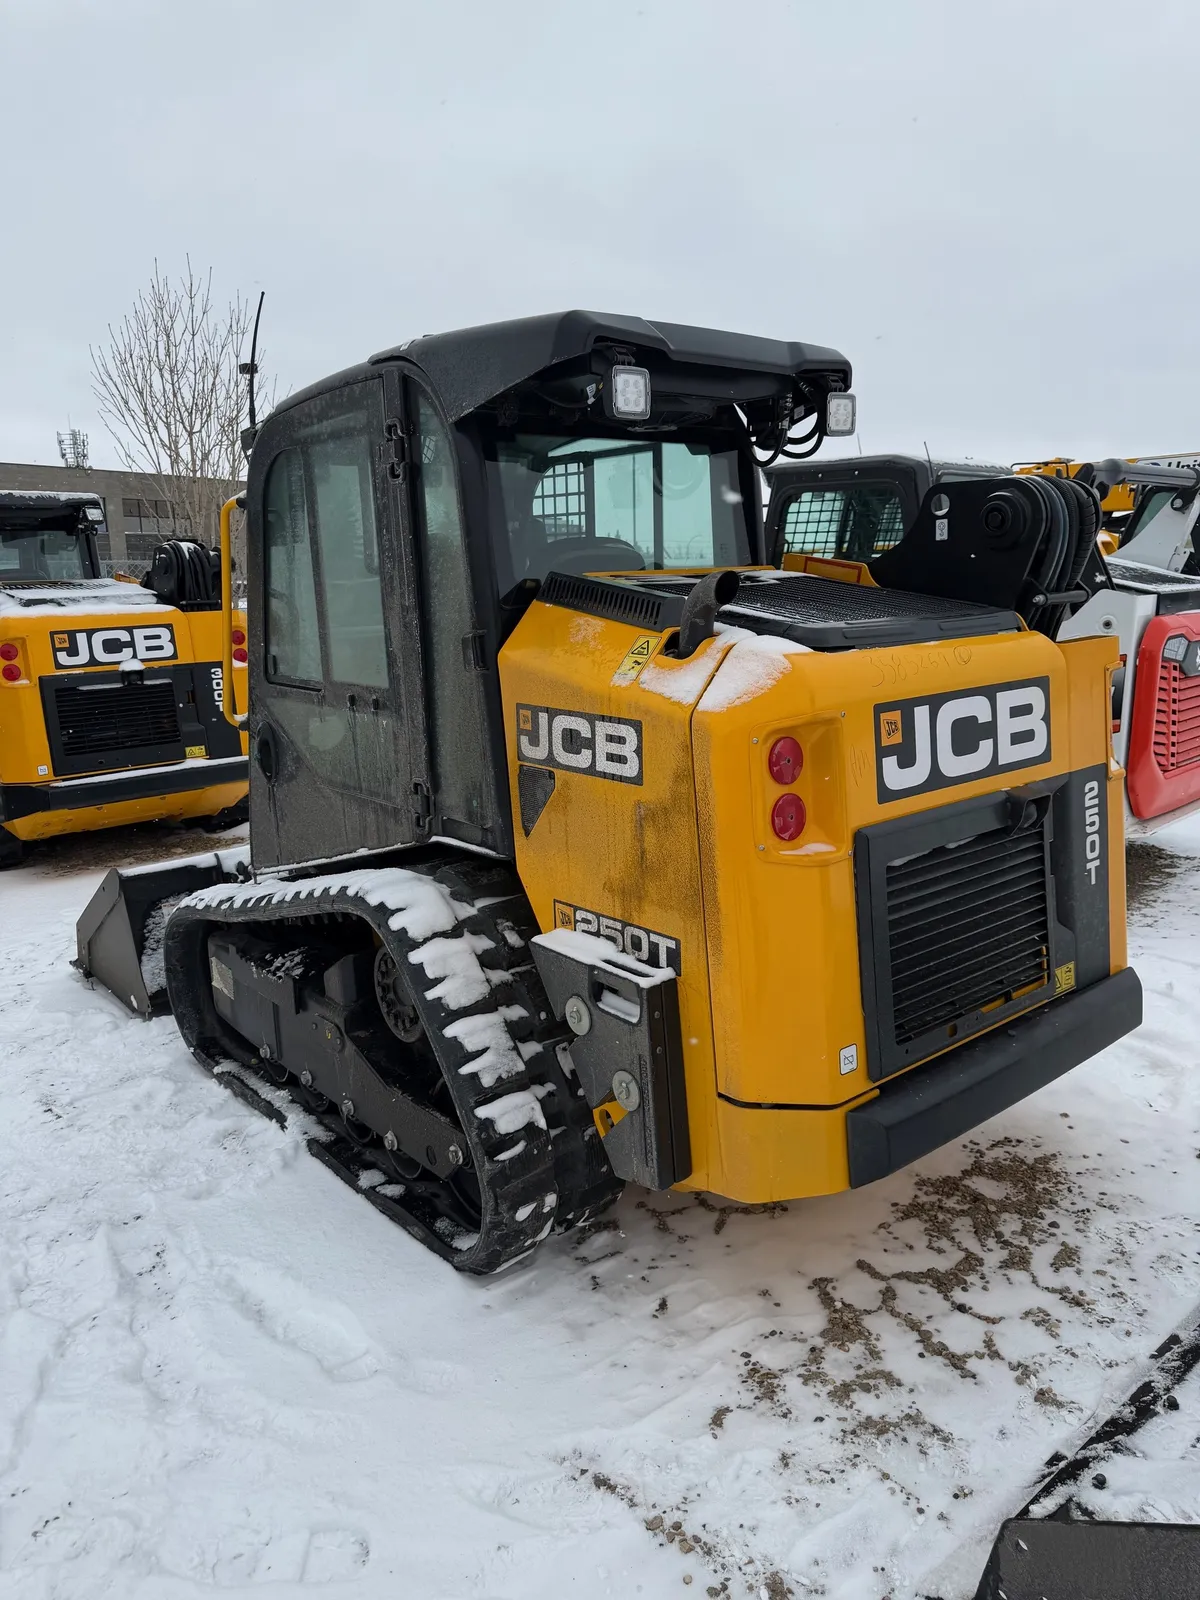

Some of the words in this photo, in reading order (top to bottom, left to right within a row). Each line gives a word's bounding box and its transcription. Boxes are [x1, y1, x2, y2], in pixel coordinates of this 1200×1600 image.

[57, 627, 174, 665] JCB
[211, 668, 223, 711] 300T
[521, 712, 639, 777] JCB
[882, 686, 1047, 790] JCB
[885, 720, 899, 736] JCB
[1085, 781, 1100, 885] 250T
[575, 909, 675, 968] 250T
